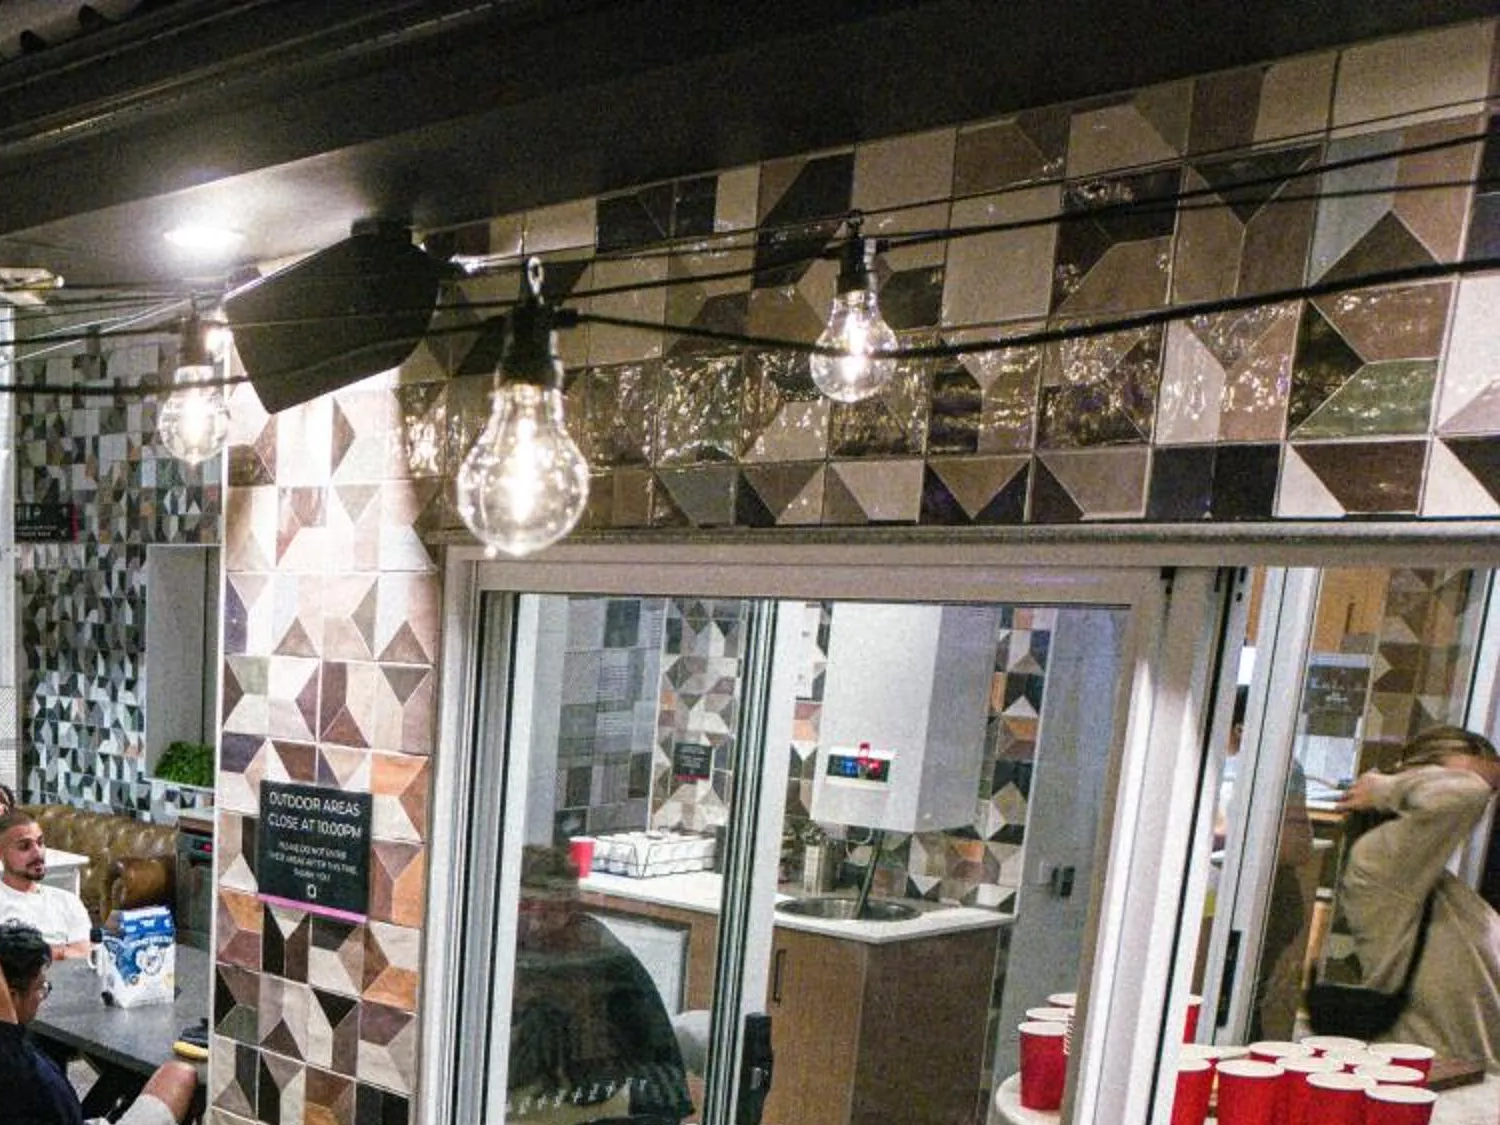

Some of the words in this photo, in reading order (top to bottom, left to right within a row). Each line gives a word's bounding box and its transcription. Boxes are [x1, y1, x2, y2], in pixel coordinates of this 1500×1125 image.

[269, 791, 321, 811] OUTDOOR
[323, 799, 361, 817] AREAS
[267, 812, 299, 831] CLOSE
[301, 817, 316, 831] AT
